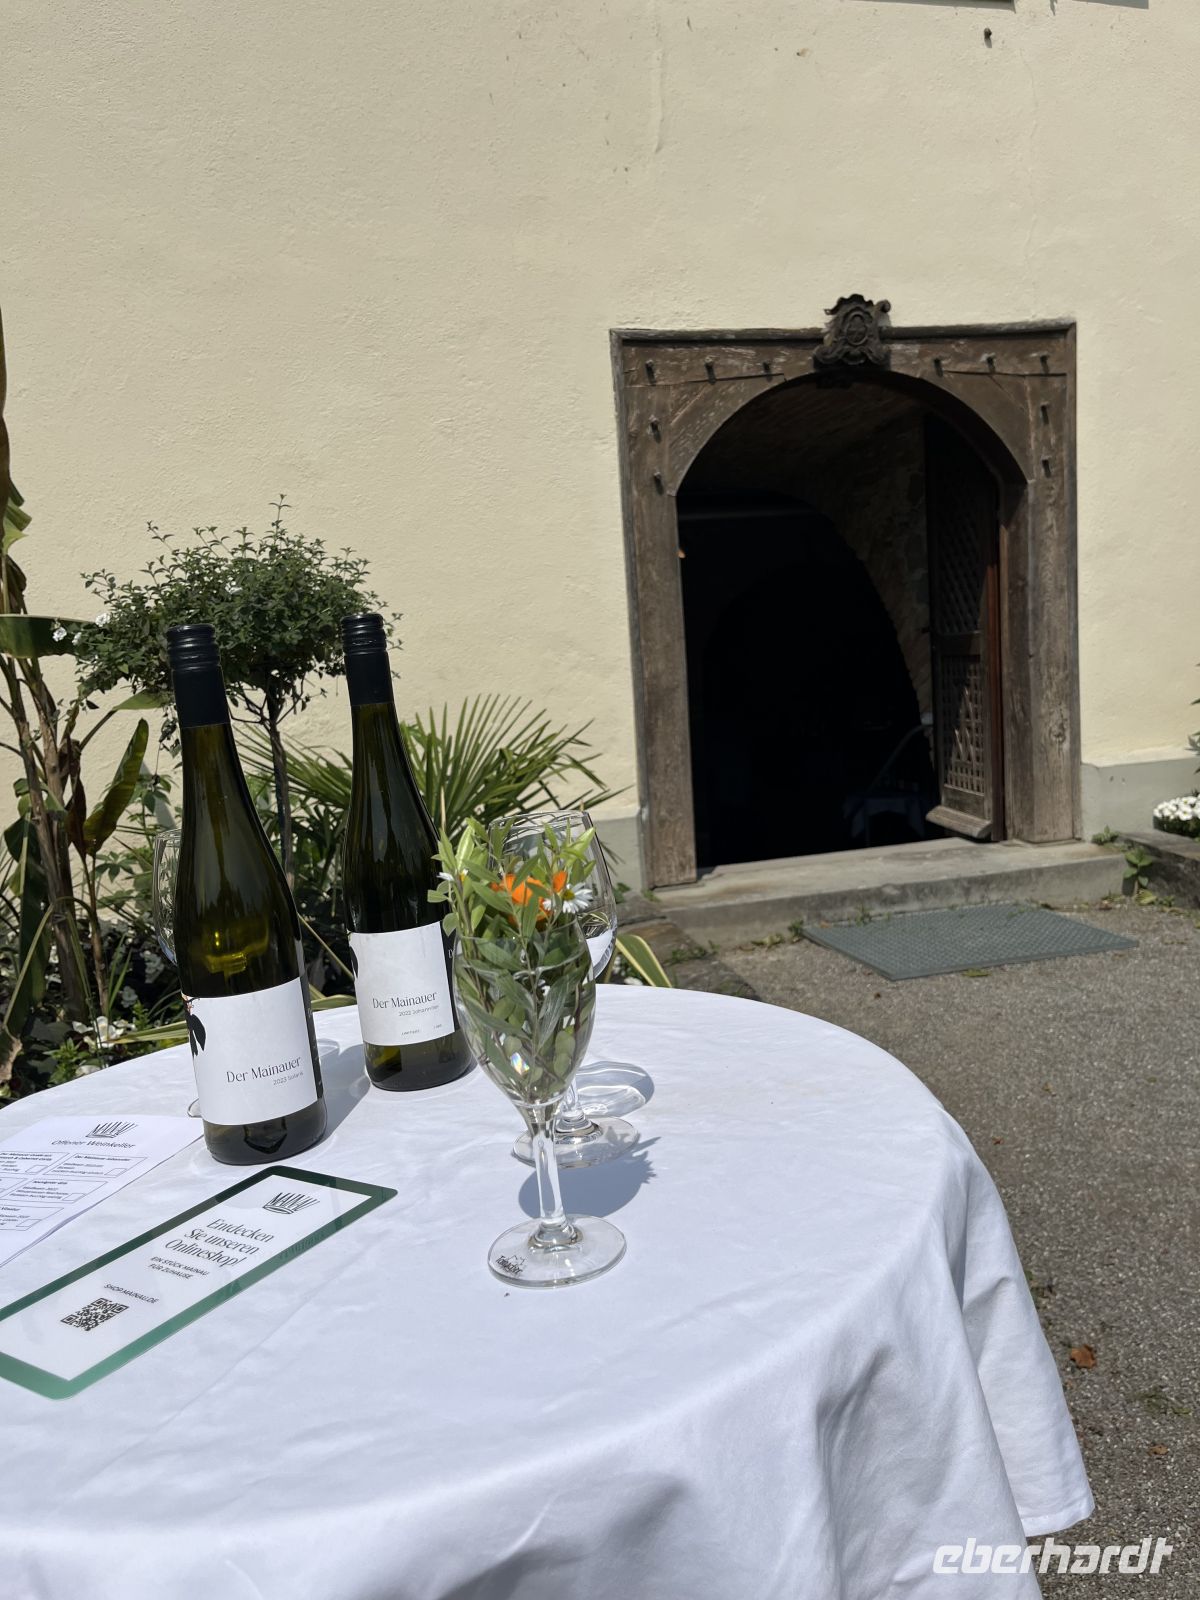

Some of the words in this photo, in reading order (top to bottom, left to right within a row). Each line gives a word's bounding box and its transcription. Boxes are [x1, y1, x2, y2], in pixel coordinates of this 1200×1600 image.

[372, 998, 389, 1009] Der
[390, 992, 437, 1008] Mainauer
[226, 1070, 248, 1083] Der
[250, 1056, 301, 1079] Mainauer
[86, 1139, 136, 1149] Weinkeller
[206, 1218, 275, 1242] Entdecken
[184, 1228, 207, 1241] Sie
[204, 1235, 260, 1255] unseren
[165, 1239, 248, 1268] Onlineshop!
[161, 1267, 194, 1279] ZUHAUSE
[182, 1265, 210, 1276] MAINAU
